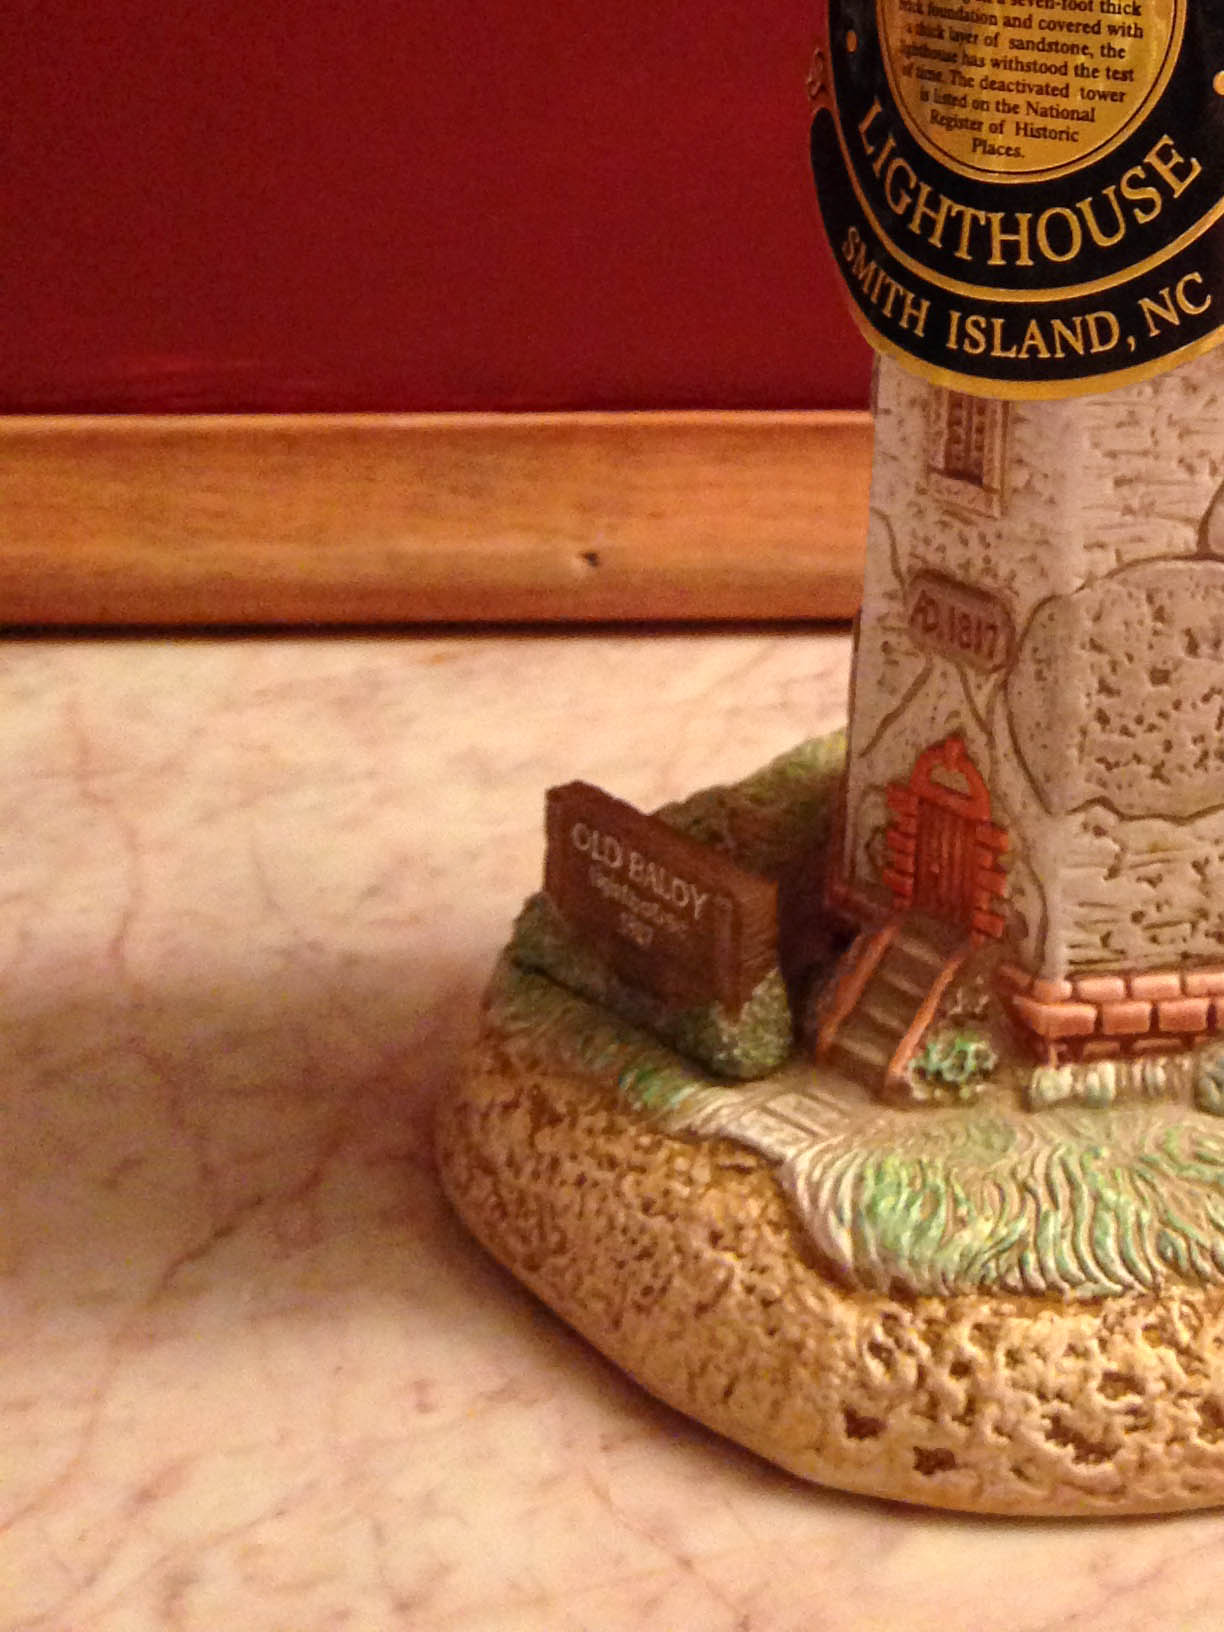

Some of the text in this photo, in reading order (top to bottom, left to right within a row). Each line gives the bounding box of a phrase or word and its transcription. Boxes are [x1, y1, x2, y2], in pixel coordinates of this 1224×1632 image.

[1003, 13, 1033, 30] and
[1038, 18, 1102, 36] covered
[1107, 22, 1144, 40] with
[983, 31, 1000, 48] of
[1008, 36, 1094, 59] sandstone,
[1100, 42, 1127, 60] the
[990, 55, 1069, 77] withstood
[1074, 62, 1100, 79] the
[1105, 65, 1135, 83] test
[950, 69, 975, 88] The
[980, 74, 1070, 99] deactivated
[1080, 87, 1127, 103] tower
[930, 108, 1080, 143] Register of Historic
[972, 98, 990, 112] on
[995, 97, 1020, 115] the
[1025, 99, 1096, 123] National
[971, 136, 1025, 159] Places.
[858, 98, 1203, 267] LIGHTHOUSE
[842, 226, 1213, 360] SMITH ISLAND, NC
[571, 822, 624, 869] OLD
[628, 850, 709, 921] BALDY
